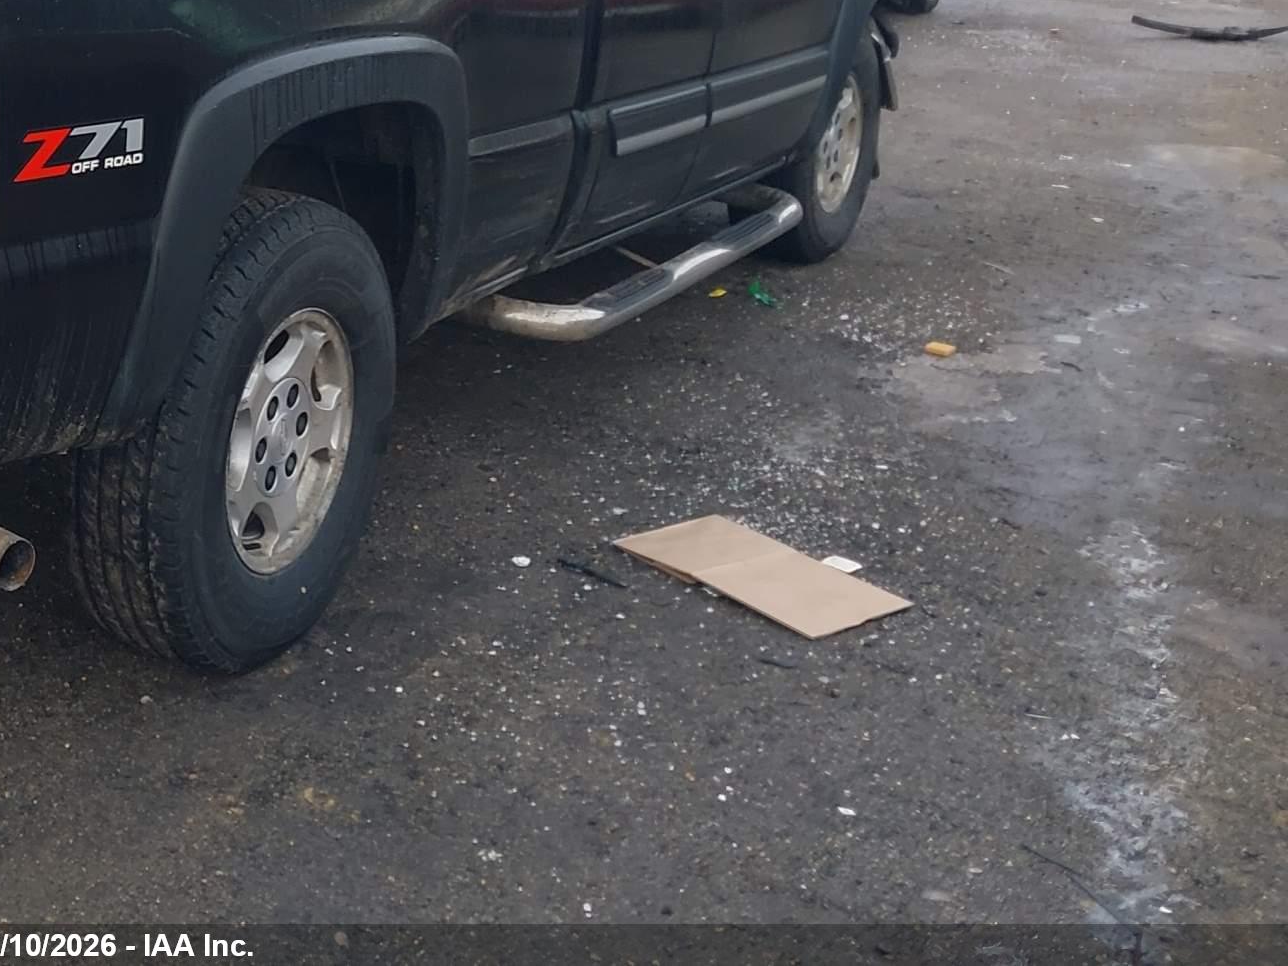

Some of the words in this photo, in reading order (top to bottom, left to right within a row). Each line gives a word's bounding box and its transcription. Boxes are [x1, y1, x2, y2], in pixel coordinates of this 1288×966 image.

[12, 117, 144, 183] Z71
[71, 159, 100, 175] OFF
[103, 152, 144, 169] ROAD
